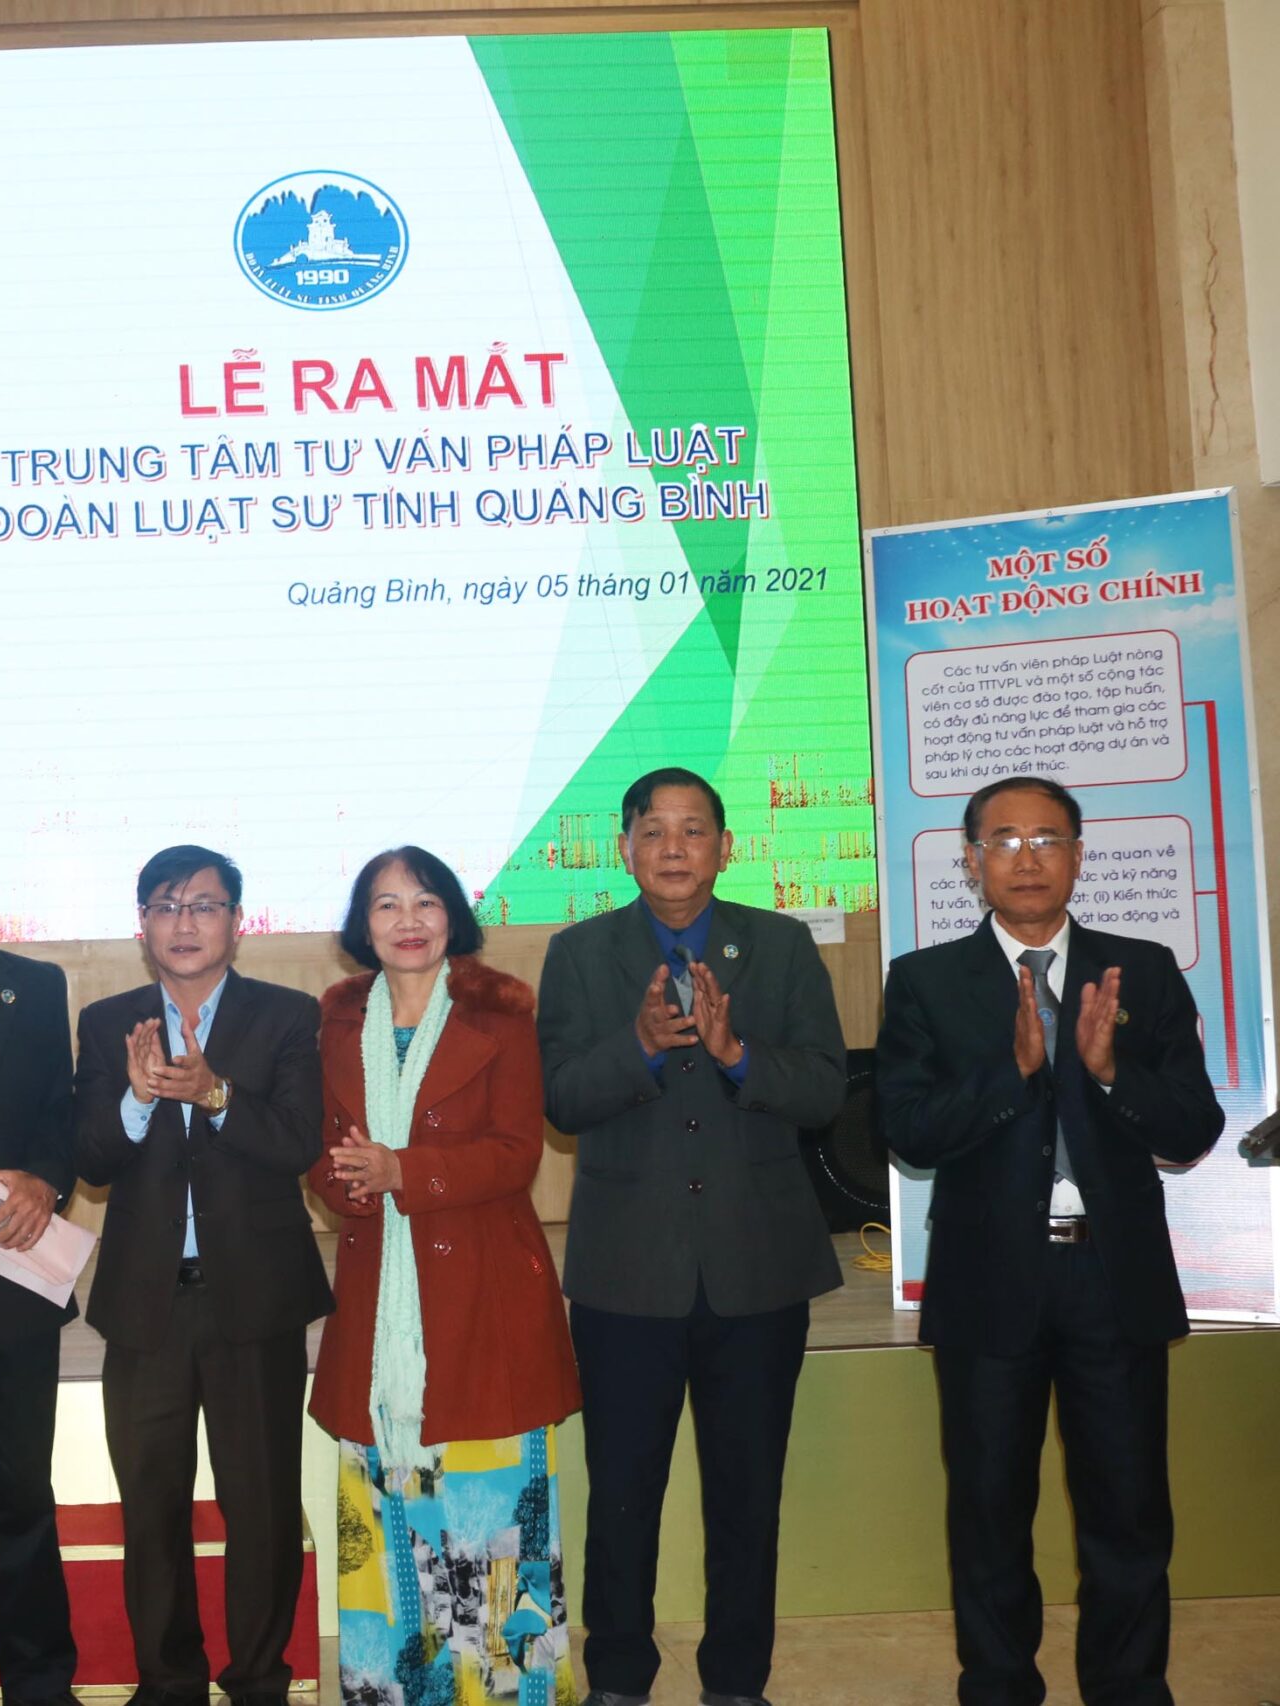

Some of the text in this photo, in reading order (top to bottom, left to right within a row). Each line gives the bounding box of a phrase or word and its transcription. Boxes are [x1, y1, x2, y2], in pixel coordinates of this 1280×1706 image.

[296, 269, 349, 286] 1990
[179, 341, 567, 417] LỄ RA MẮT
[0, 445, 167, 486] TRUNG
[180, 433, 280, 479] TÂM
[294, 438, 362, 475] TƯ
[487, 423, 613, 471] PHÁP
[625, 422, 747, 475] LUẬT
[133, 496, 258, 543] LUẬT
[271, 493, 342, 532] SƯ
[658, 471, 769, 522] BÌNH
[988, 536, 1108, 580] MỘT SỐ
[287, 566, 829, 609] Quảng Bình, ngày 05 tháng 01 năm 2021
[907, 570, 1202, 623] HOẠT ĐỘNG CHÍNH
[943, 648, 1163, 678] Các tư vấn viên pháp Luật nòng
[921, 665, 1165, 696] cốt của và một số cộng tác
[922, 700, 951, 713] viên
[953, 699, 972, 711] cơ
[975, 696, 990, 709] sở
[993, 694, 1029, 709] được
[1032, 691, 1062, 704] đào
[1096, 686, 1122, 700] tập
[1124, 681, 1166, 696] huấn,
[923, 699, 1167, 730] có đầy đủ năng lực để tham gia các
[923, 716, 1169, 747] hoạt động tư vấn pháp luật và hỗ trợ
[924, 733, 1170, 765] pháp lý cho các hoạt động dự án và
[925, 768, 948, 780] sau
[950, 766, 969, 778] khi
[971, 764, 990, 778] dự
[991, 762, 1010, 776] án
[1012, 760, 1032, 774] kết
[1111, 844, 1176, 862] quan về
[929, 878, 957, 891] các
[1101, 867, 1178, 882] và kỹ năng
[930, 899, 945, 910] tư
[947, 896, 975, 910] vấn,
[1093, 886, 1179, 905] (ii) Kiến thức
[931, 917, 951, 930] hỏi
[1097, 908, 1180, 924] lao động và
